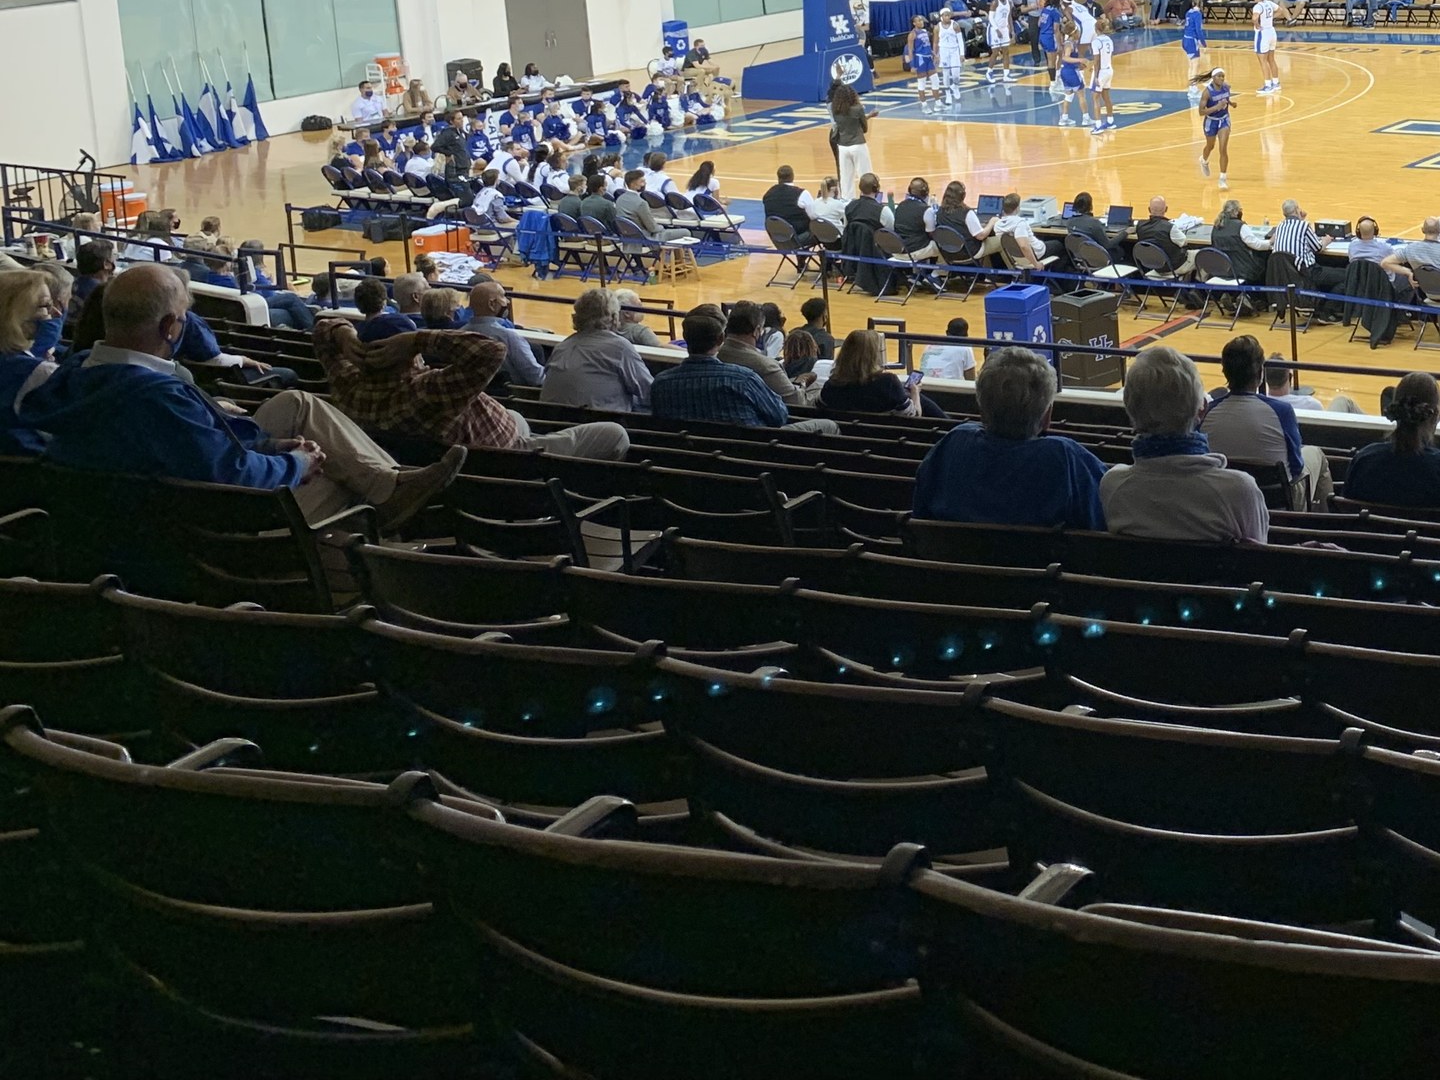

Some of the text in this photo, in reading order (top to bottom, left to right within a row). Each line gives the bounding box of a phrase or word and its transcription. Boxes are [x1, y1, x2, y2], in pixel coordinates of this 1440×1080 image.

[1264, 8, 1272, 18] 12
[830, 14, 850, 35] UK
[1105, 44, 1111, 54] 3
